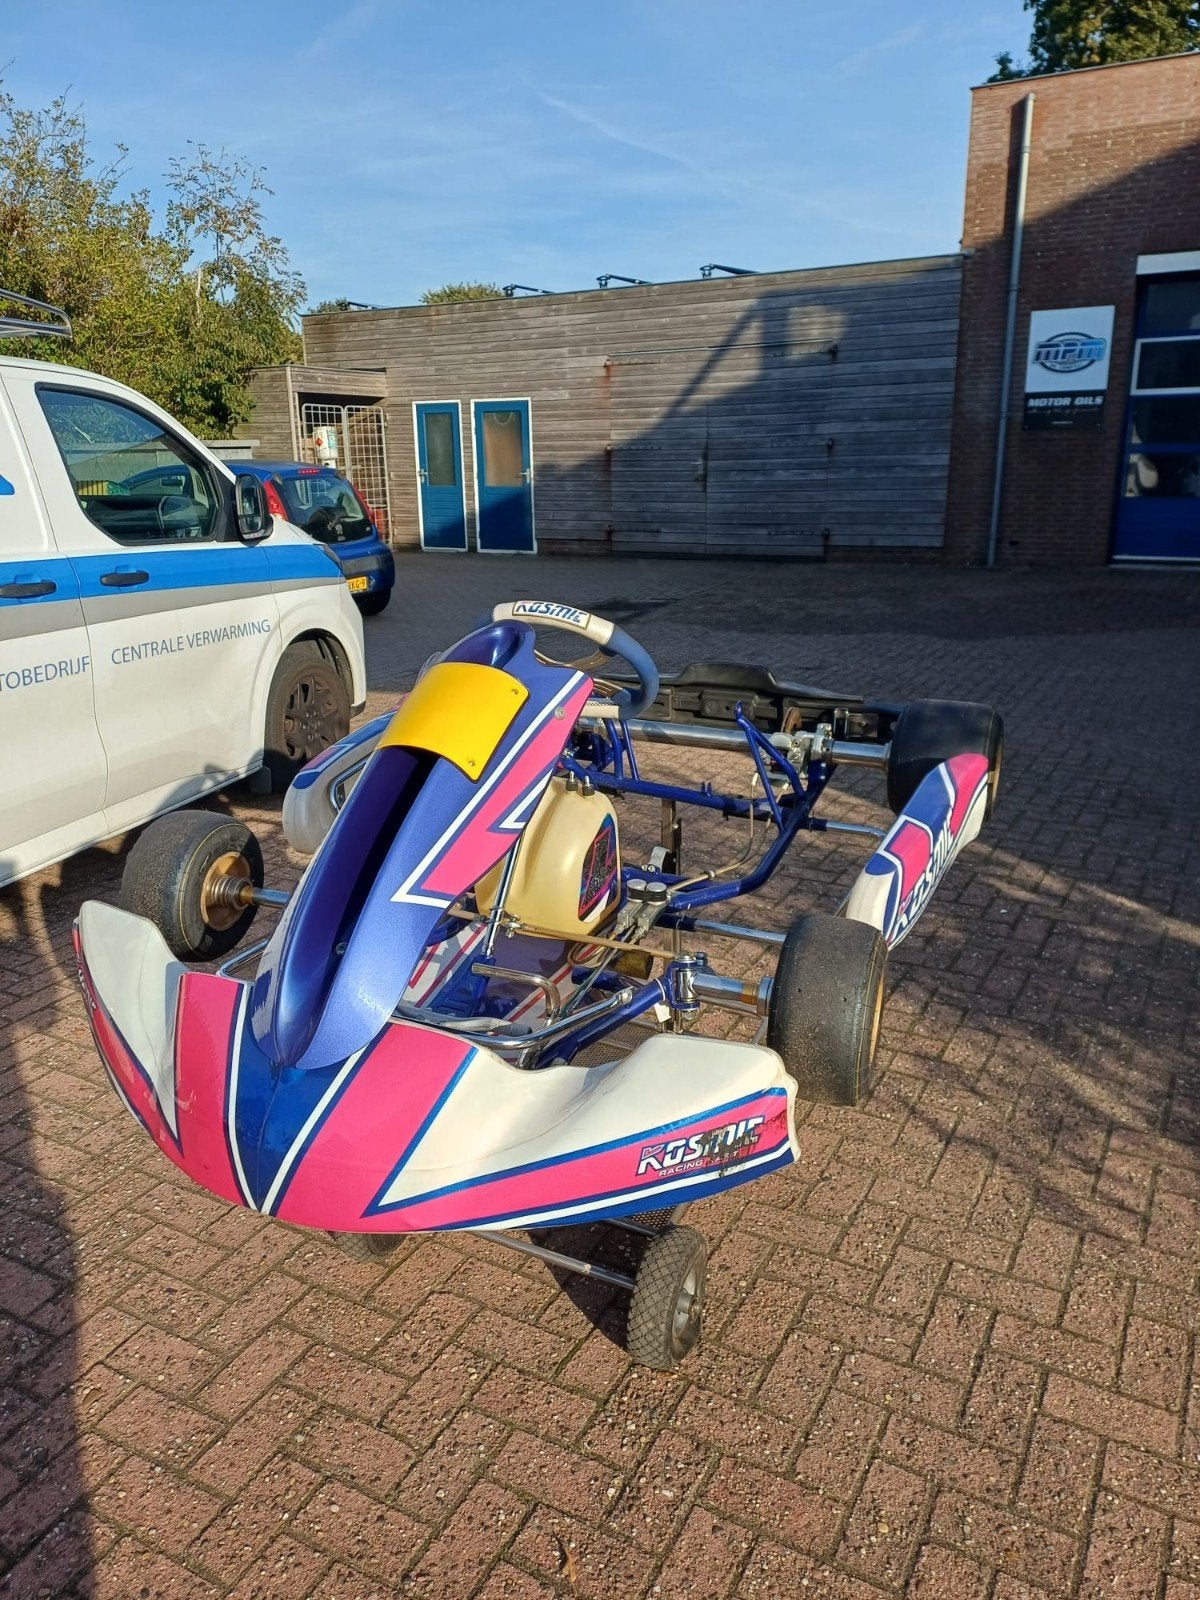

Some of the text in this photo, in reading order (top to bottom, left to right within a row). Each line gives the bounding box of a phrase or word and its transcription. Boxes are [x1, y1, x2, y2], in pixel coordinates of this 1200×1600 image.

[1027, 395, 1104, 408] MOTOR OILS
[111, 636, 185, 665] CENTRALE
[186, 619, 271, 649] VERWARMING
